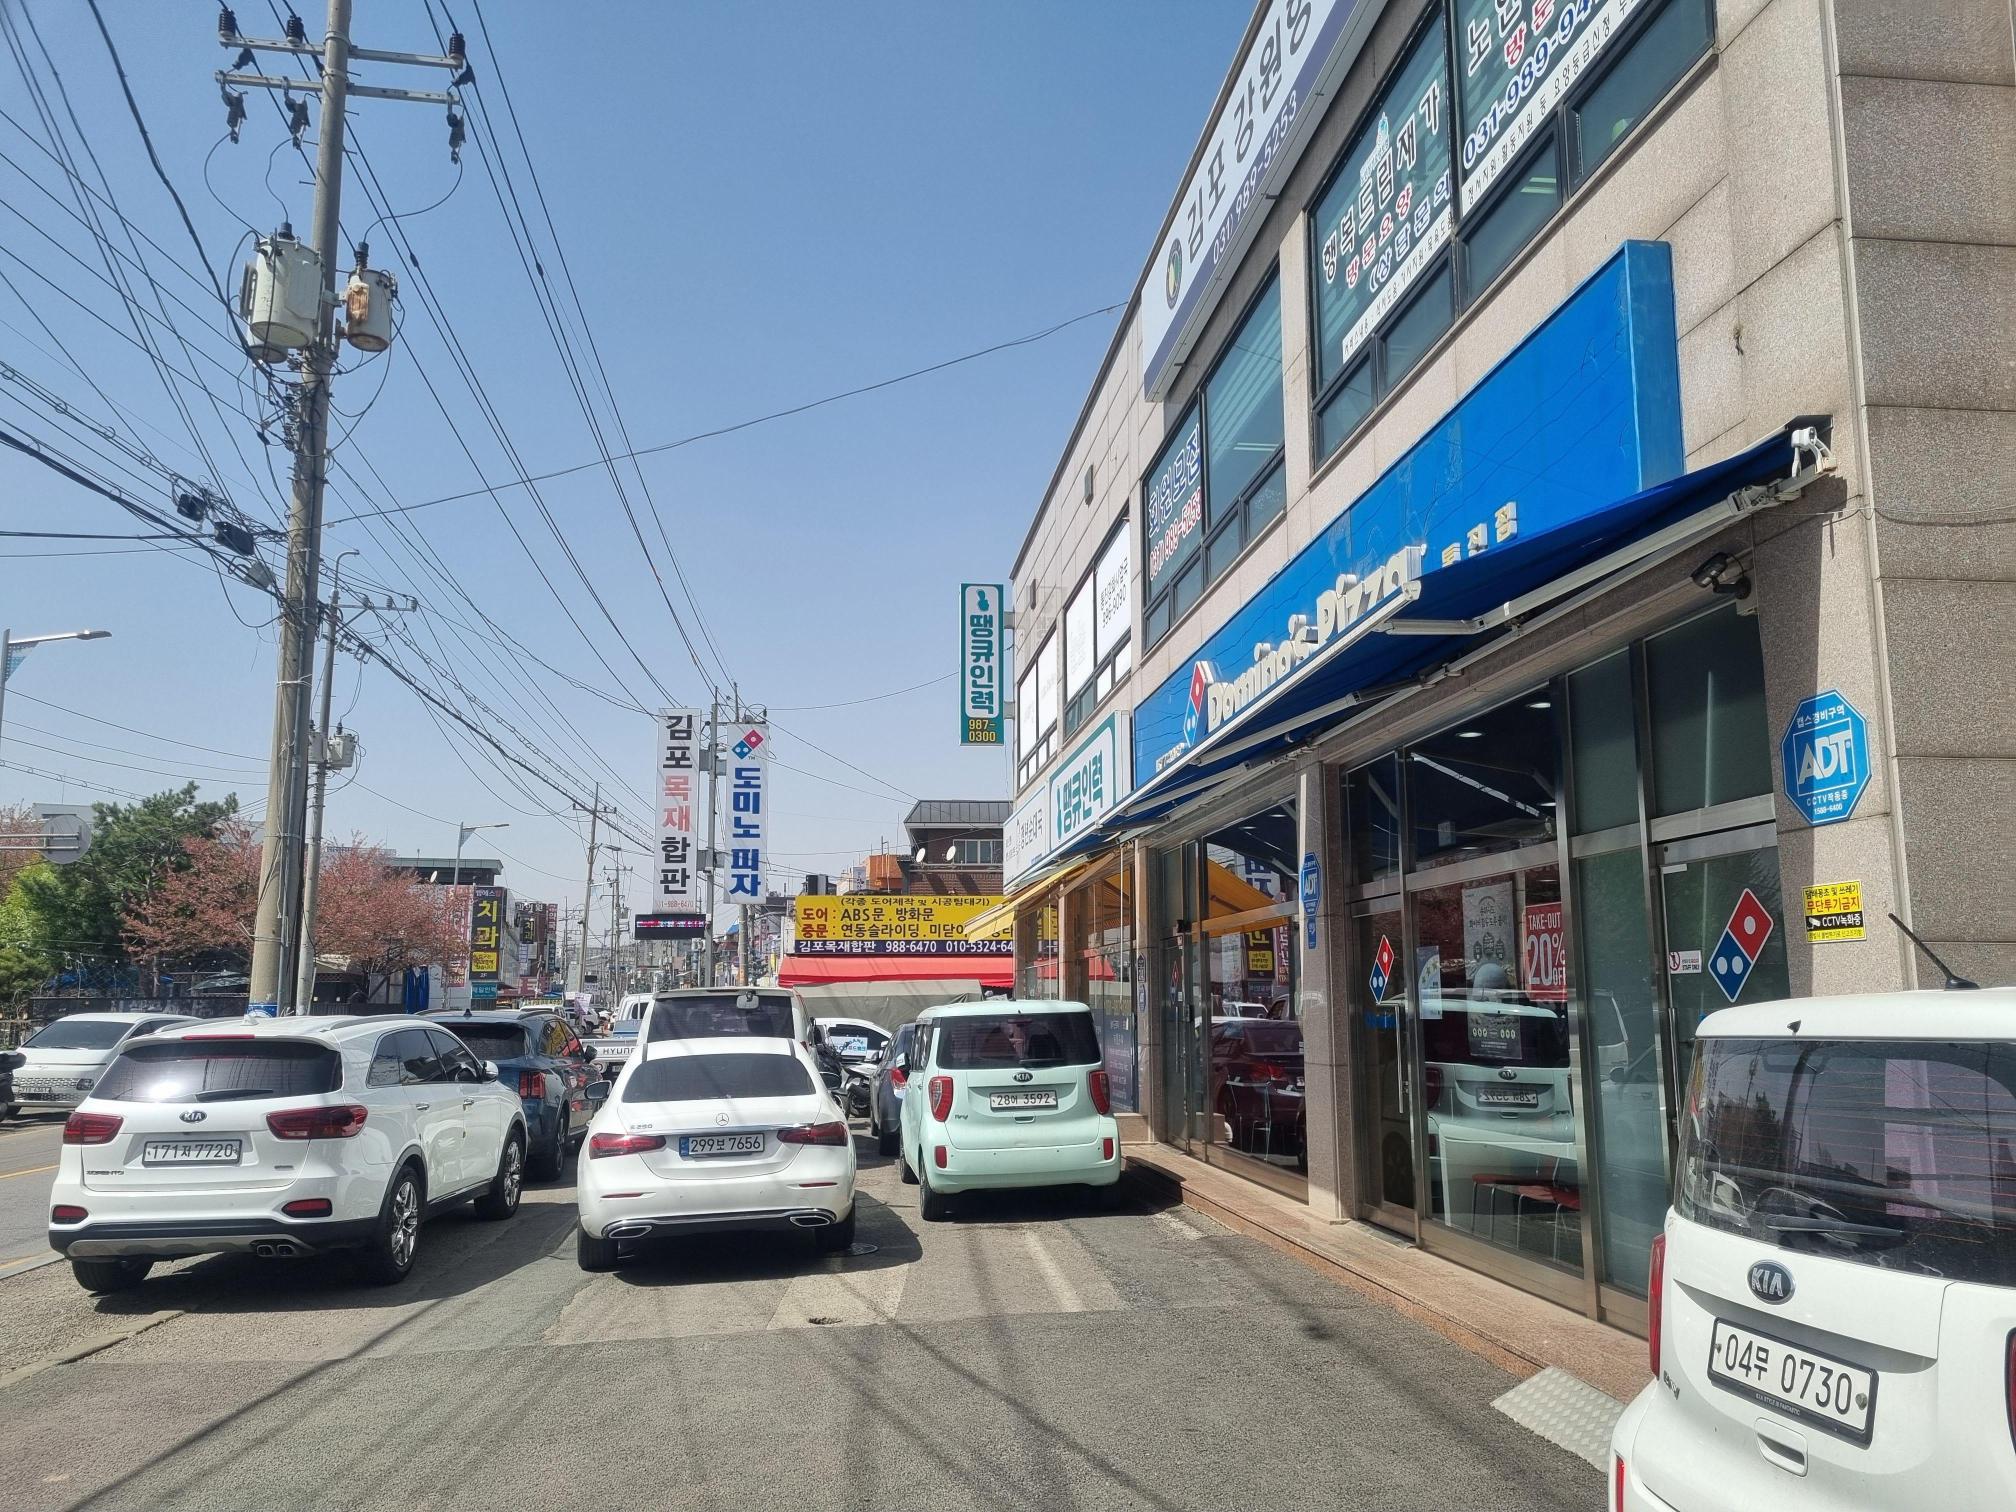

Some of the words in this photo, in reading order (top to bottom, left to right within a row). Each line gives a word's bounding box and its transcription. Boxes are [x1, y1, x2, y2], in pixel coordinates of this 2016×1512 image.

[1236, 89, 1297, 222] 989-5253
[970, 614, 995, 714] 땡큐인력
[968, 731, 996, 742] 0300
[1798, 730, 1852, 785] ADT
[1063, 750, 1103, 834] 땡큐인력
[660, 714, 693, 895] 김포목재합판
[1304, 873, 1318, 897] ADT
[871, 898, 915, 906] 도어제작
[1807, 895, 1860, 915] 무단투기금지
[476, 900, 499, 948] 치과
[895, 908, 935, 922] 방화문
[1528, 912, 1561, 930] TAKE-OUT
[1822, 913, 1862, 927] CCTV녹화중
[841, 924, 919, 938] 연동슬라이딩
[799, 941, 876, 953] 김포목재합판
[885, 941, 937, 953] 988-6470
[1015, 1073, 1031, 1081] KIA
[1023, 1093, 1050, 1105] 3592
[195, 1143, 233, 1158] 7720
[729, 1136, 761, 1150] 7656
[1751, 1266, 1784, 1297] KIA
[1724, 1333, 1769, 1381] 04무
[1780, 1353, 1853, 1416] 0730
